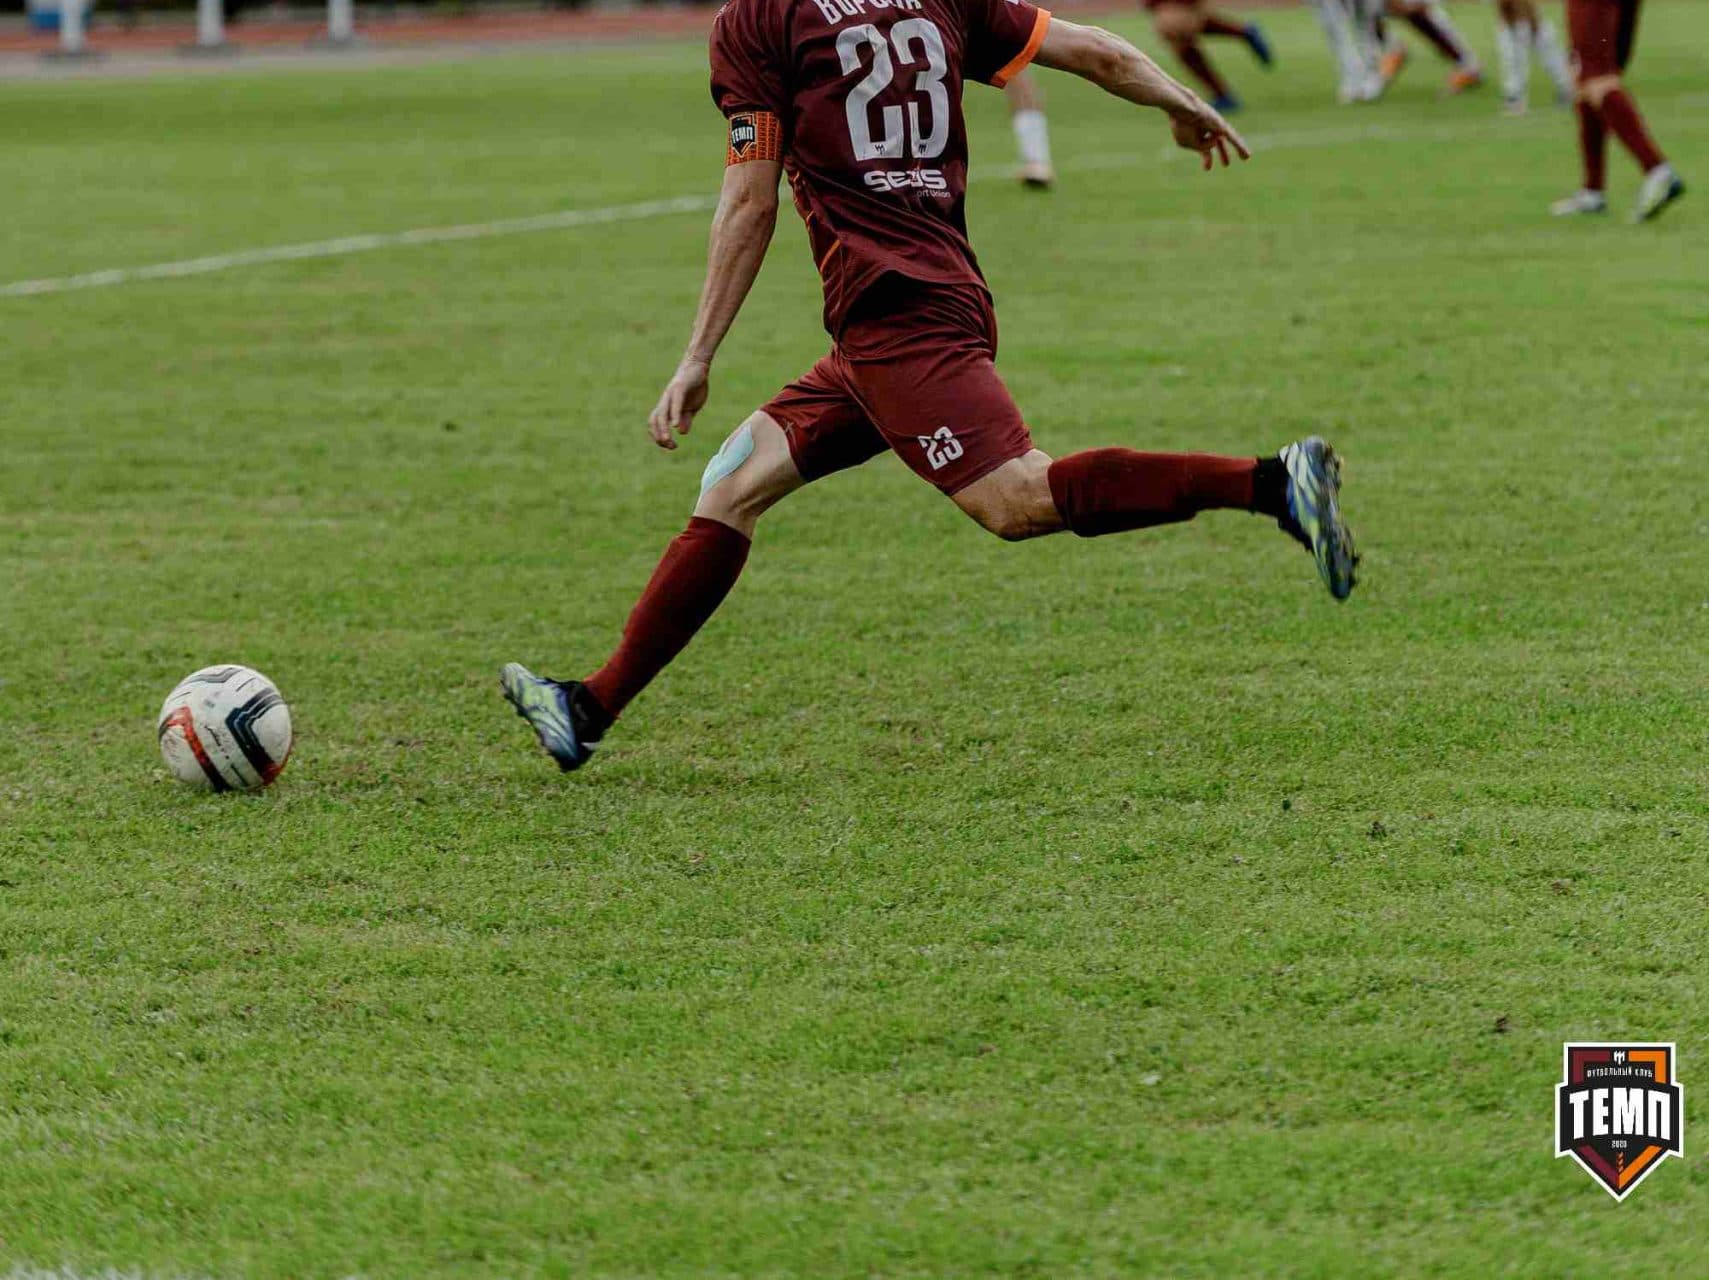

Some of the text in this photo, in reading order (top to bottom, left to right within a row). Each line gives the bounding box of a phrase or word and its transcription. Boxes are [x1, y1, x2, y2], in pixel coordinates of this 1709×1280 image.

[836, 17, 949, 161] 23
[731, 126, 754, 145] ТЕМП
[917, 426, 964, 470] 23
